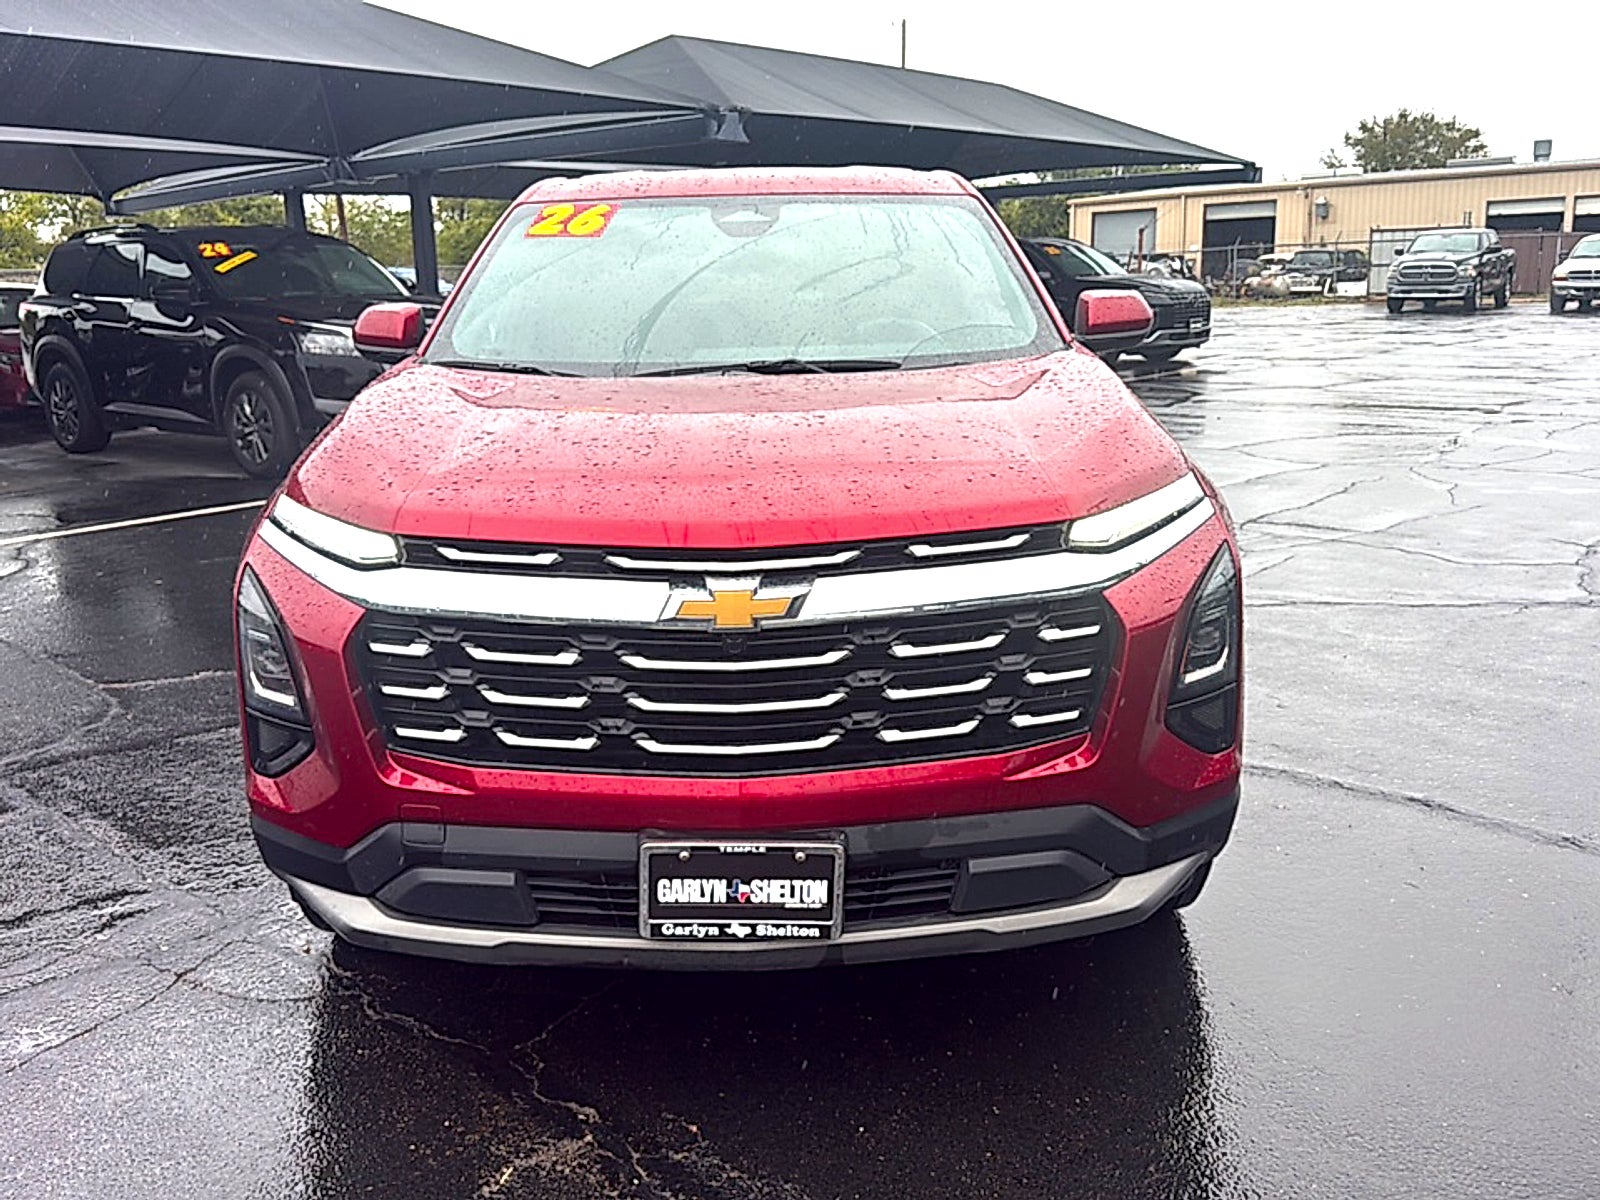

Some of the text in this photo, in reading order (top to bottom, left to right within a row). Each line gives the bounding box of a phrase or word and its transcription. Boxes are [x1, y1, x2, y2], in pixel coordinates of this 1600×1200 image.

[528, 204, 611, 235] 26
[719, 845, 766, 853] TEMPLE
[657, 878, 828, 904] GARLYN SHELTON
[661, 923, 820, 938] Garlyn Shelton
